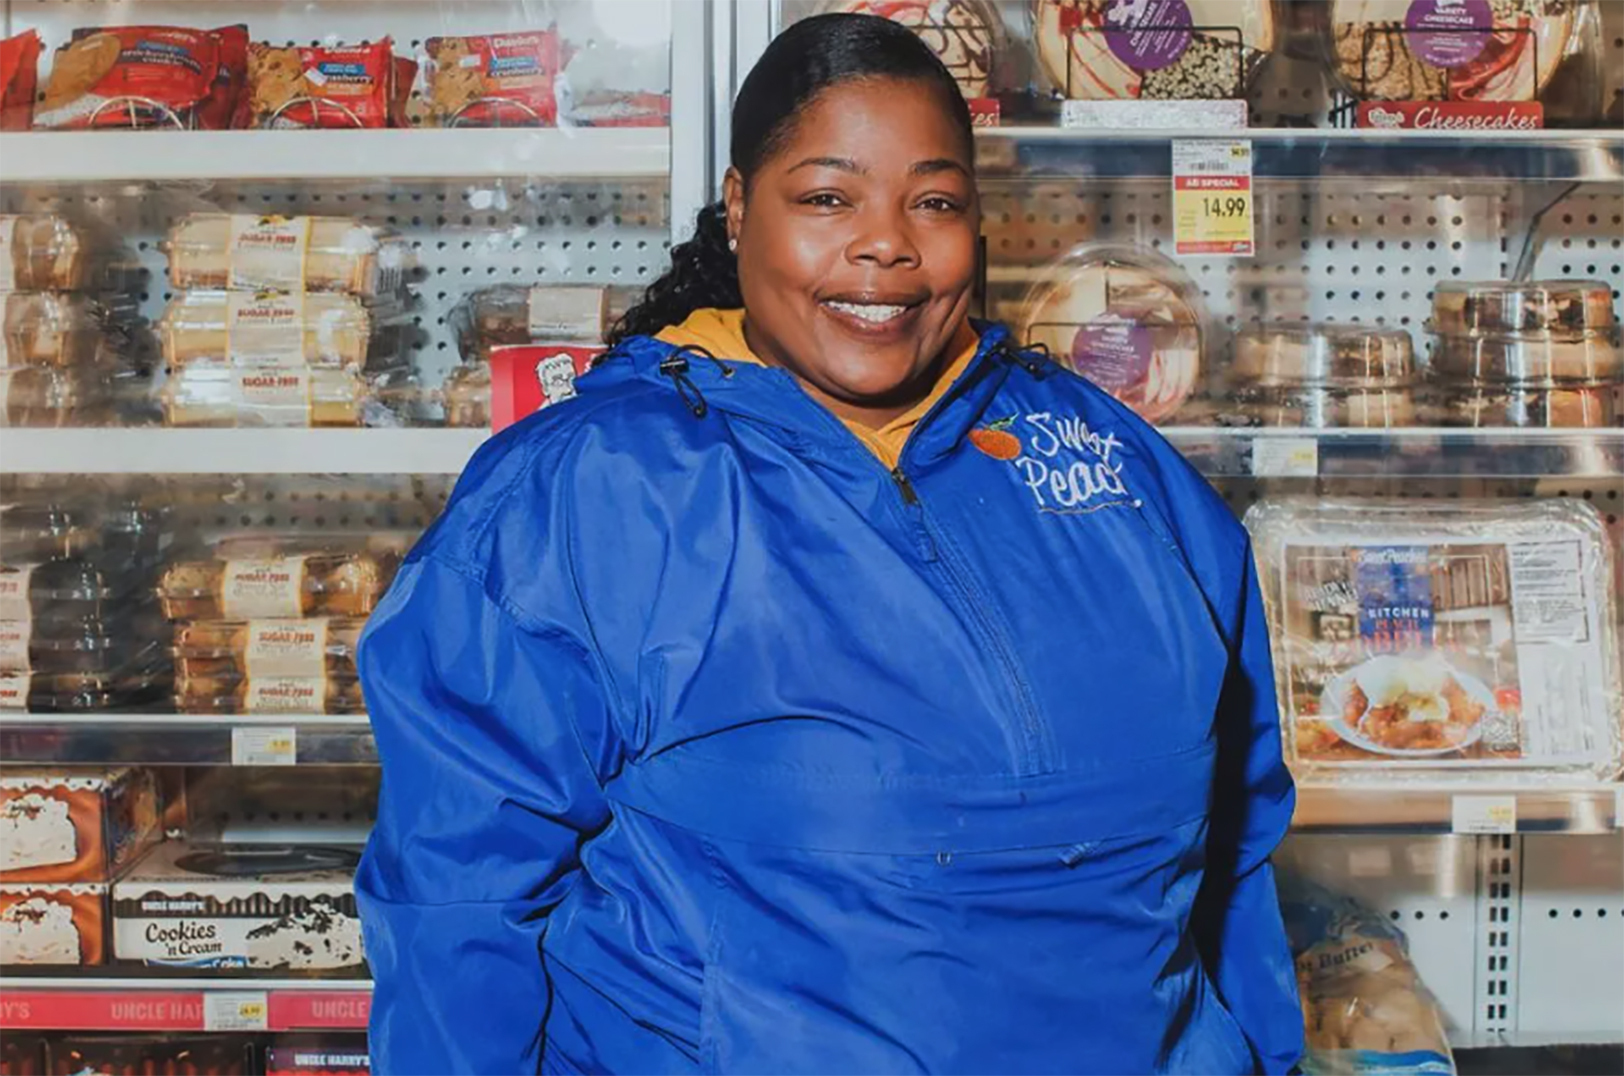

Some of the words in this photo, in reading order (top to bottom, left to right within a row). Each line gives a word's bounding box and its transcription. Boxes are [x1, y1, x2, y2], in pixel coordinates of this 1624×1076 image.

[1414, 106, 1539, 129] Cheesecakes
[1202, 178, 1240, 188] SPECIAL
[1203, 197, 1246, 217] 14.99
[1368, 606, 1430, 619] KITCHEN
[141, 901, 168, 911] UNCLE
[145, 920, 216, 944] Cookies
[178, 941, 222, 956] Cream
[111, 1002, 165, 1020] UNCLE
[311, 1000, 367, 1018] UNCLE
[294, 1054, 327, 1066] UNCLE
